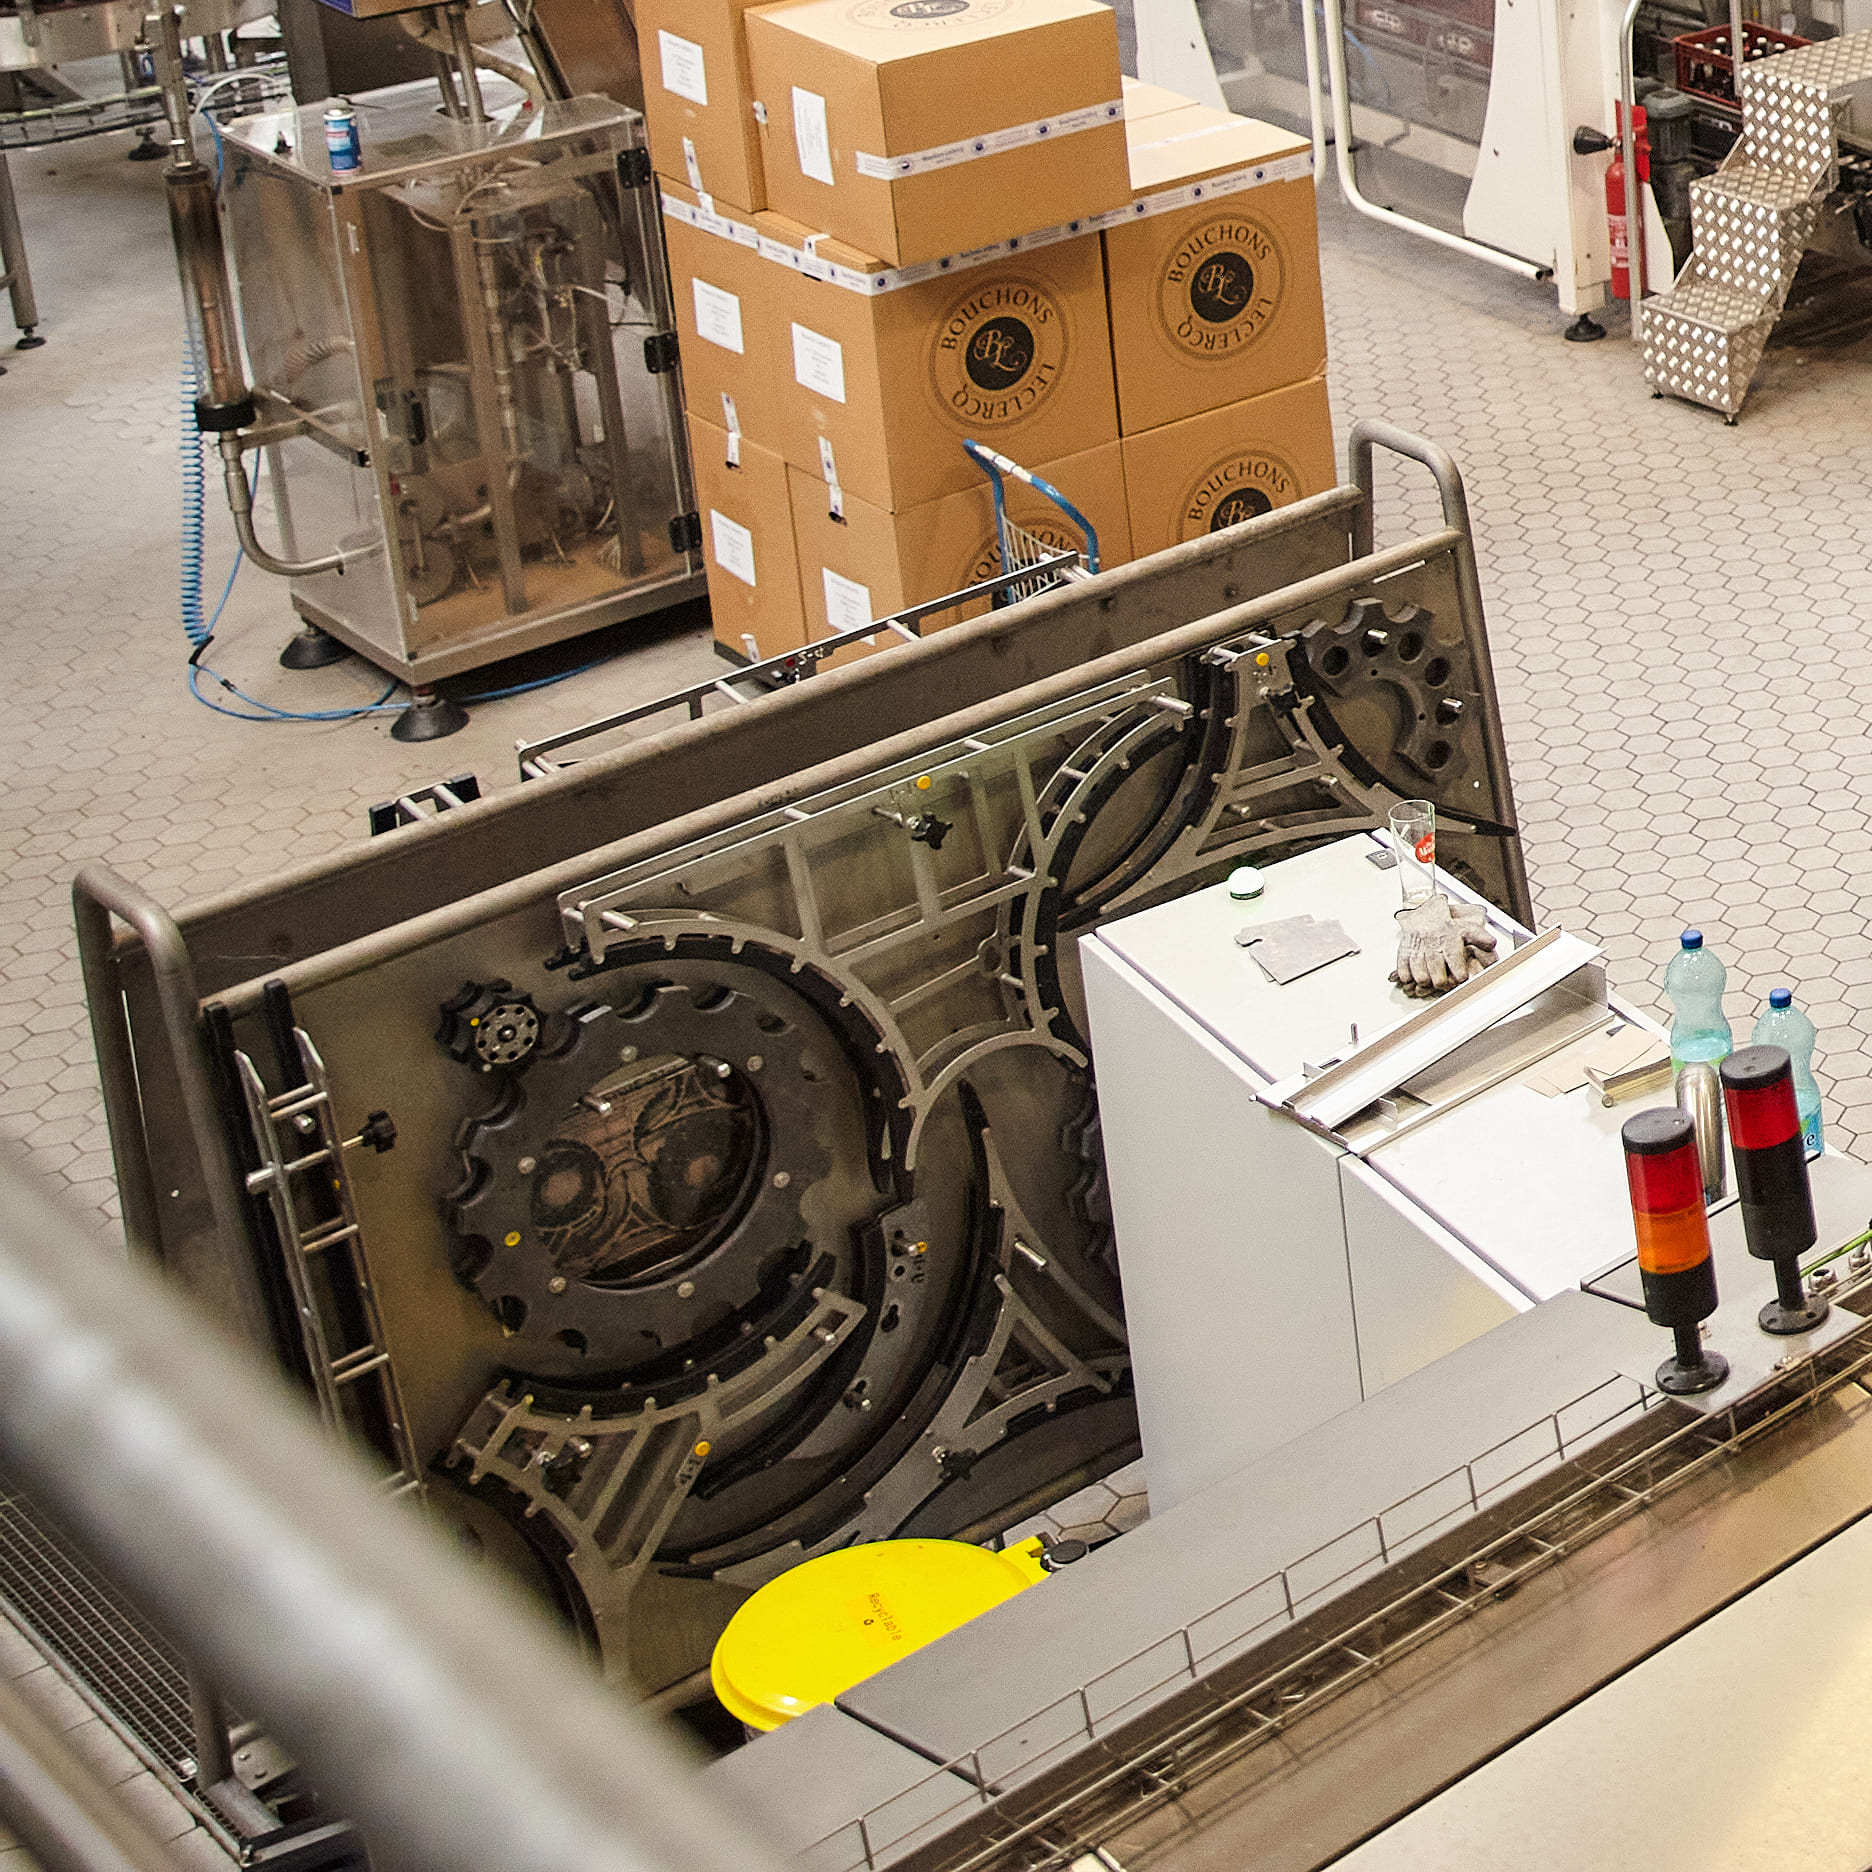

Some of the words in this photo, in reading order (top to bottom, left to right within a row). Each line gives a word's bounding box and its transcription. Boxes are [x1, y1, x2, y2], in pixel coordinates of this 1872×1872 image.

[1168, 223, 1272, 283] BOUCHONS
[940, 286, 1054, 351] BOUCHONS
[1177, 297, 1273, 351] LECLERCQ
[951, 363, 1056, 420] LECLERCQ
[1187, 460, 1291, 521] BOUCHONS
